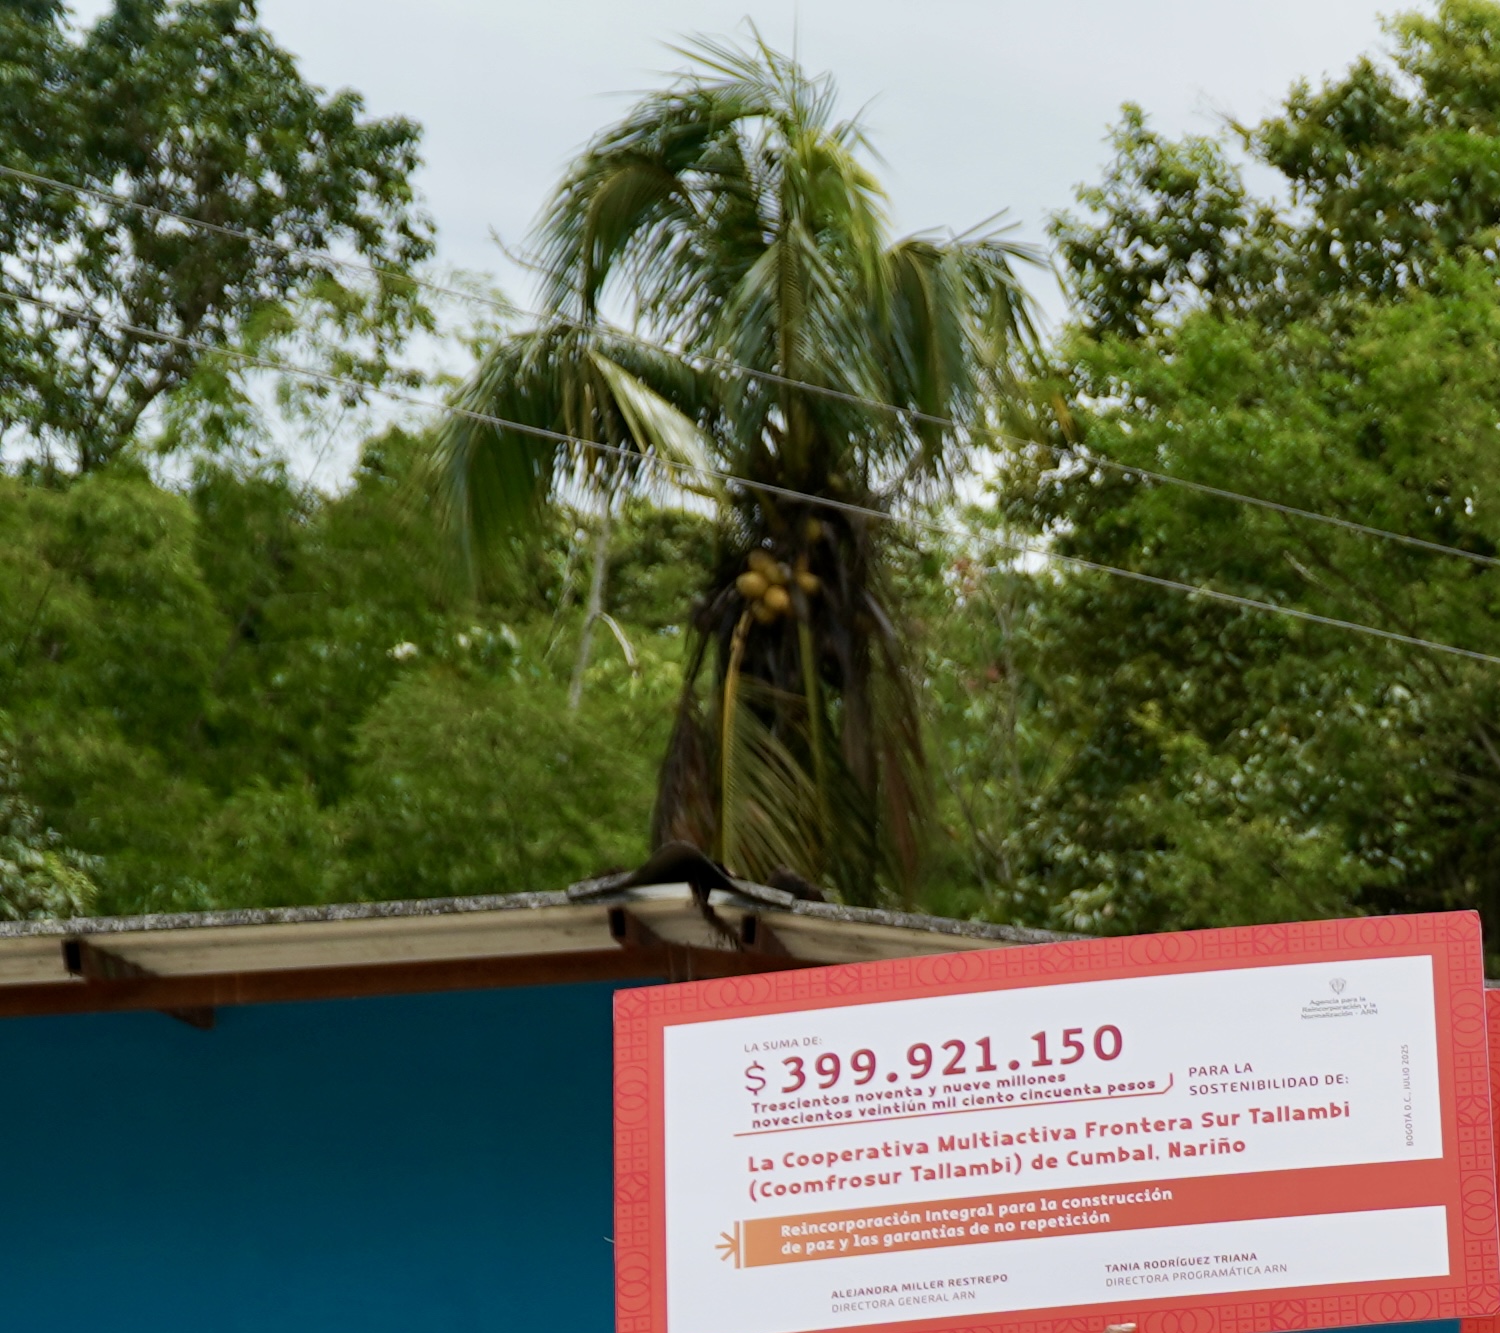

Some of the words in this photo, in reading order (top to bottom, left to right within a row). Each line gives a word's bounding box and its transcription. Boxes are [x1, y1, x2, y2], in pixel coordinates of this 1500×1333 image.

[748, 1156, 774, 1172] La
[782, 1140, 929, 1168] Cooperativa
[937, 1126, 1077, 1152] Multiactiva
[1085, 1117, 1193, 1138] Frontera
[1201, 1111, 1240, 1128] Sur
[1248, 1100, 1350, 1124] Tallambi
[749, 1171, 902, 1202] (Coomfrosur
[910, 1152, 1022, 1182] Tallambi)
[1031, 1153, 1058, 1170] de
[1066, 1143, 1159, 1167] Cumbal,
[1168, 1137, 1246, 1158] Nariño
